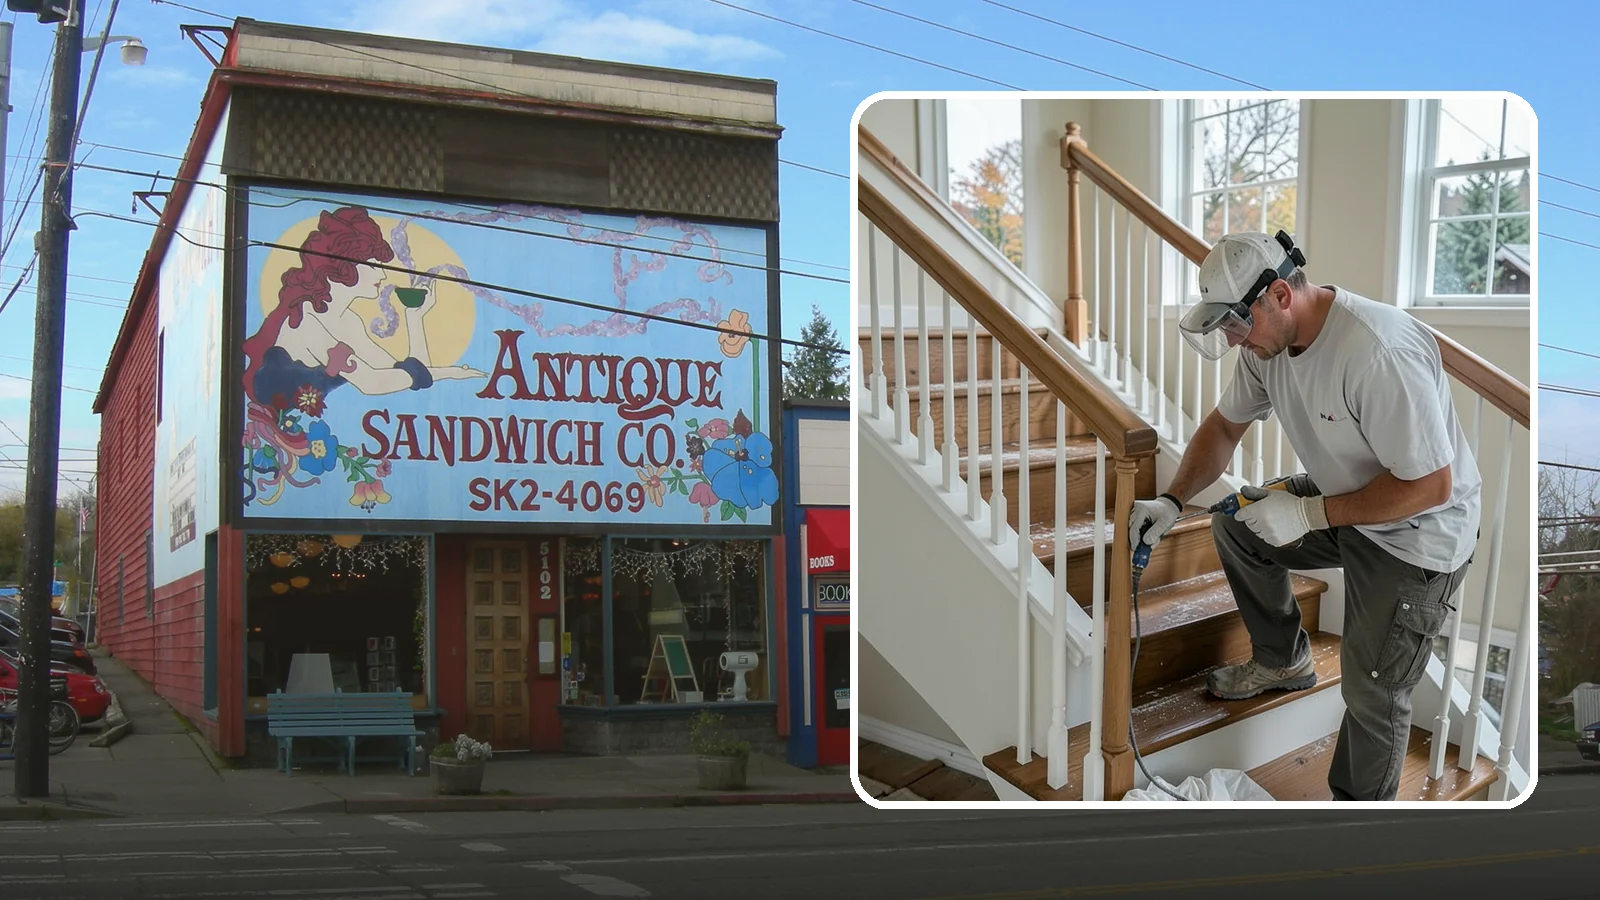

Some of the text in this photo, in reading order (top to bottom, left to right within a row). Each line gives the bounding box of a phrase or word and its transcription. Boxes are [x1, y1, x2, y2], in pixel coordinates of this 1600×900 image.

[476, 329, 724, 420] ANTIQUE
[362, 408, 685, 469] SANDWICH CO.
[468, 477, 646, 513] SK2-4069
[540, 541, 551, 600] 5102
[809, 555, 835, 569] BOOKS
